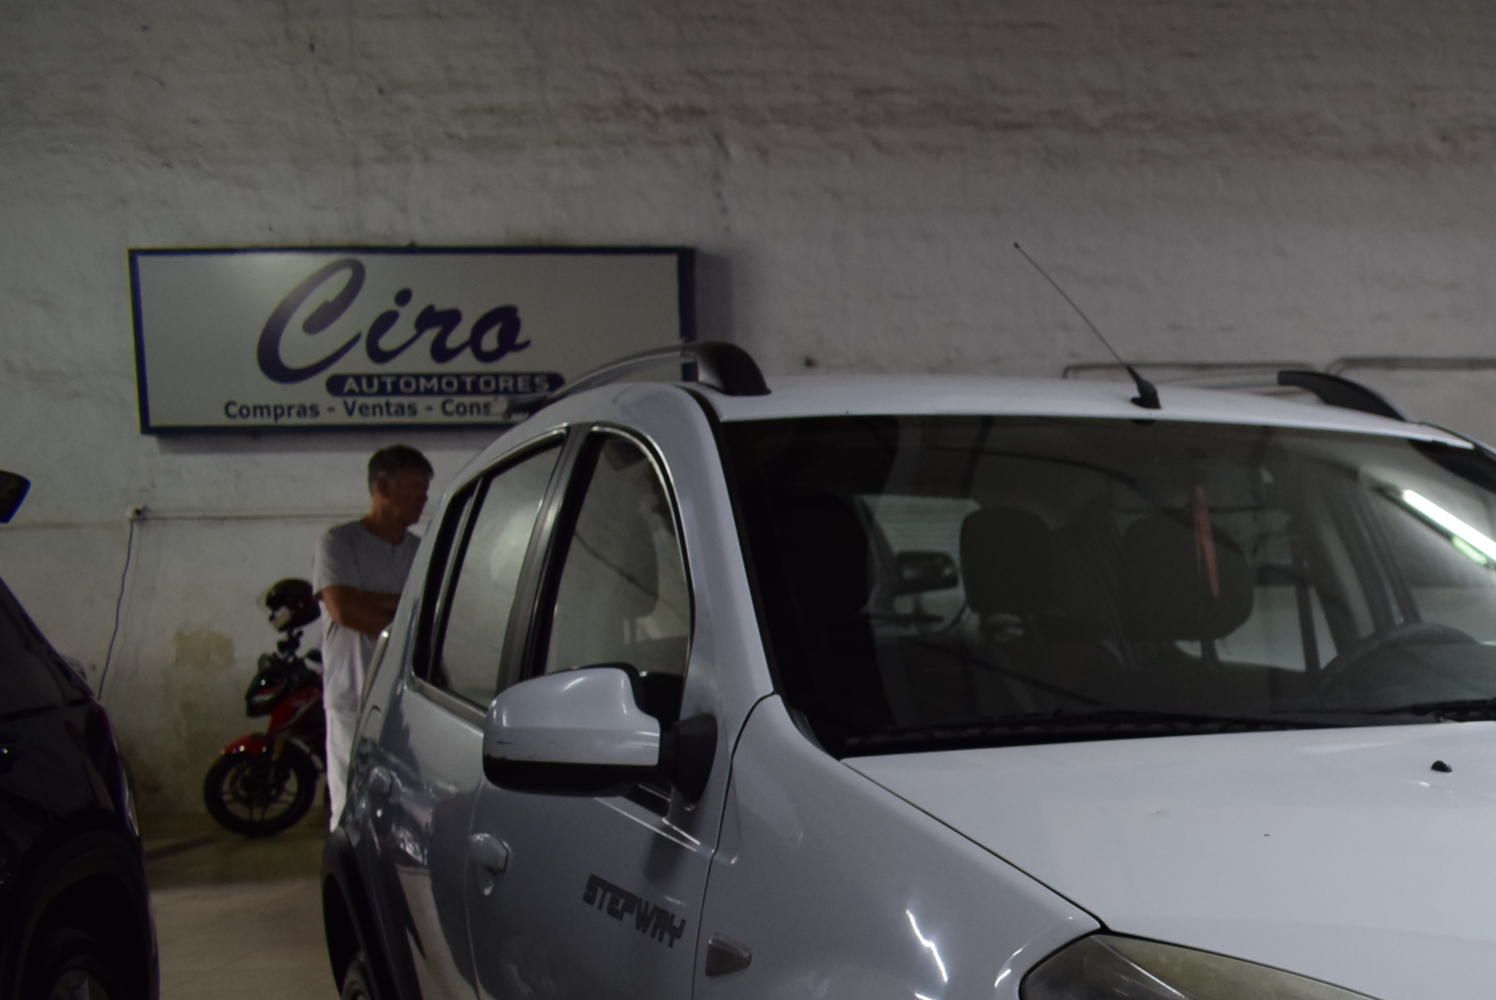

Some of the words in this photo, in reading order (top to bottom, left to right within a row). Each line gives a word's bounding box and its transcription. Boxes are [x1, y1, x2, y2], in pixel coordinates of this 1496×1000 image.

[258, 258, 531, 383] Ciro
[343, 375, 548, 394] AUTOMOTORES
[224, 400, 320, 421] Compras
[342, 399, 418, 416] Ventas
[583, 874, 687, 948] STEPWAY
